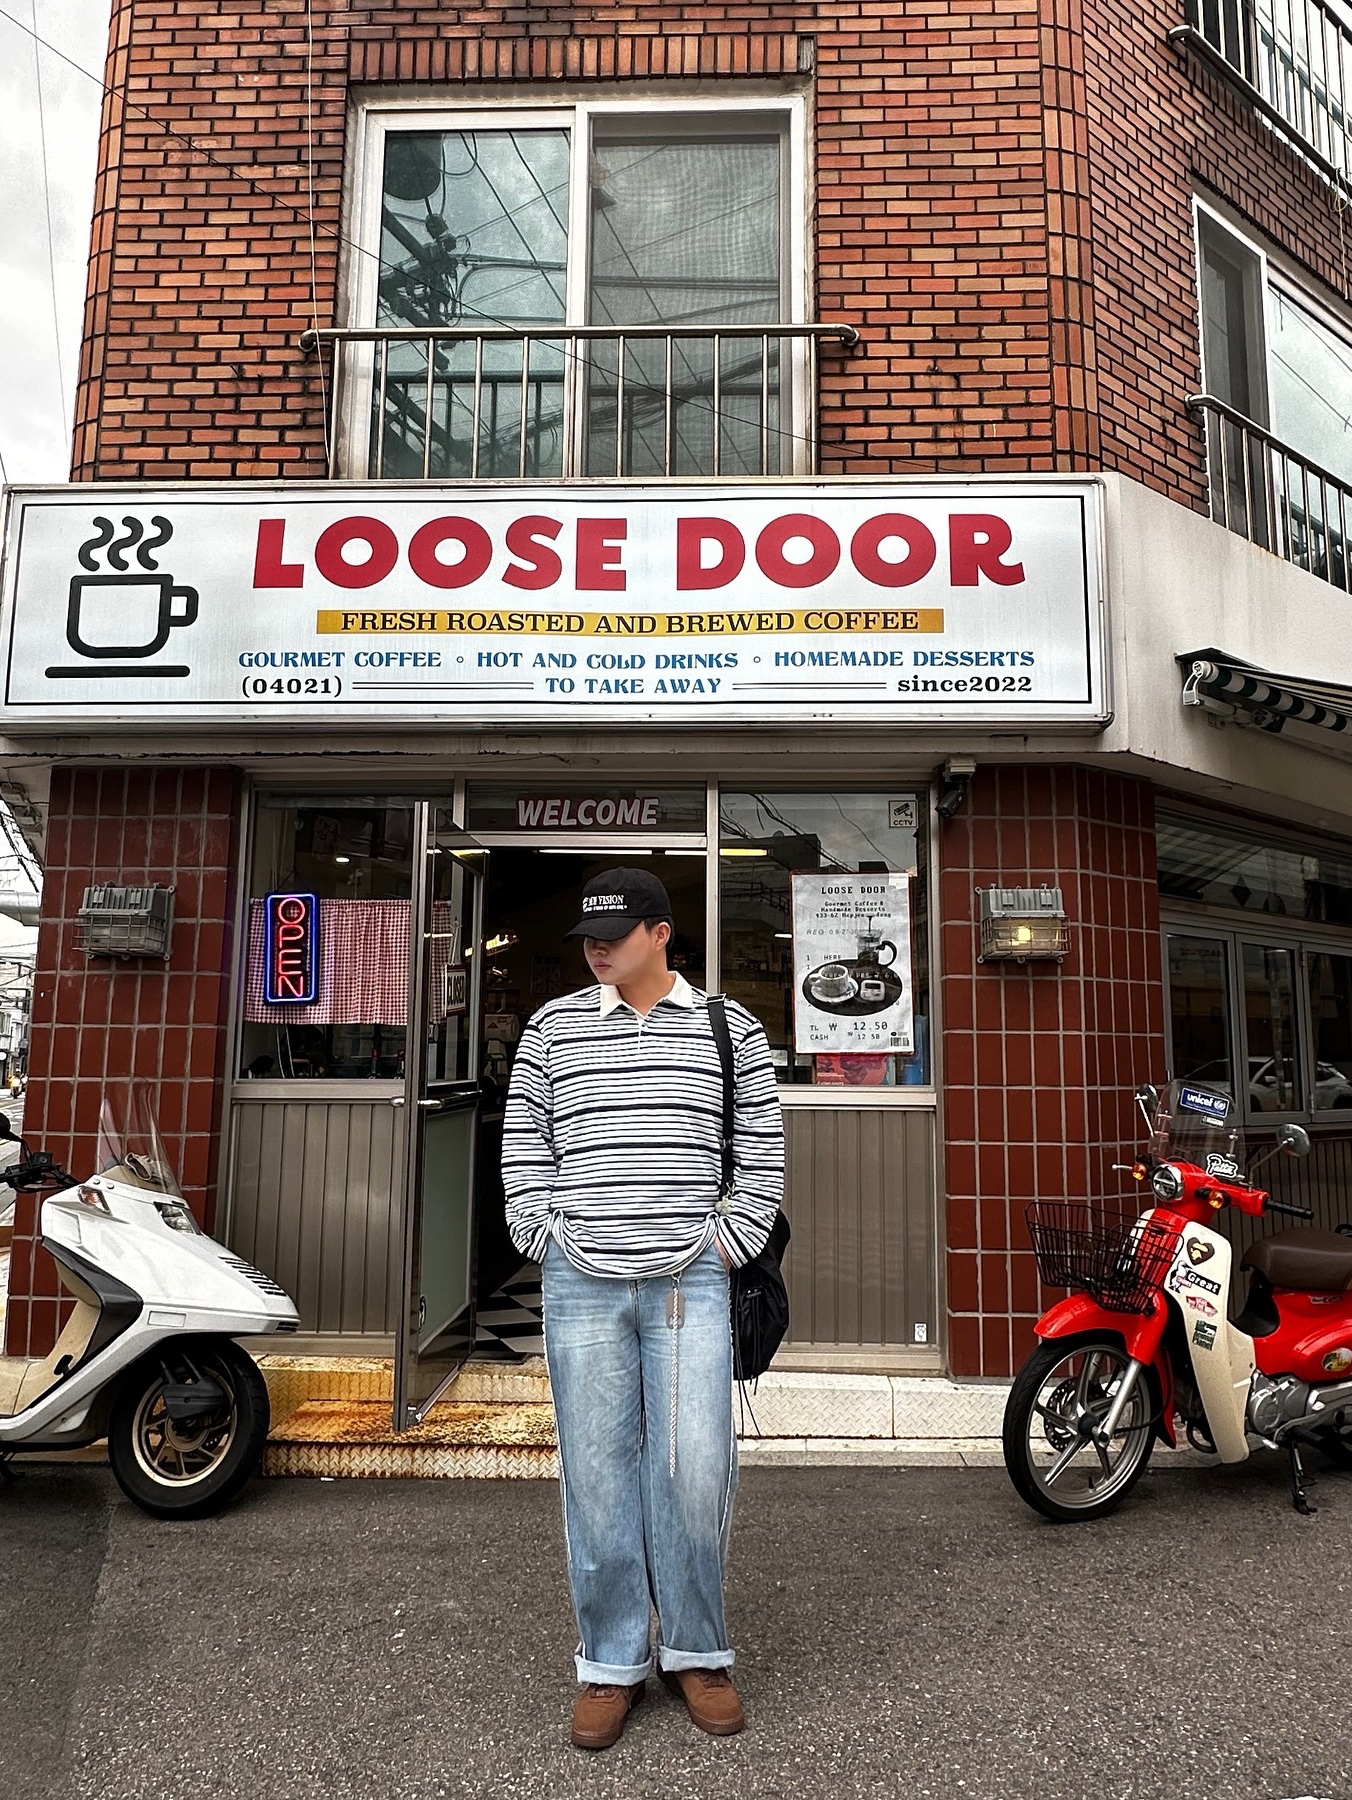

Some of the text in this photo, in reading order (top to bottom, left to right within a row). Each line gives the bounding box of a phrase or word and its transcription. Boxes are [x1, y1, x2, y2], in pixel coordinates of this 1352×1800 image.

[253, 513, 1025, 591] LOOSE DOOR
[341, 611, 919, 634] FRESH ROASTED AND BREWED COFFEE
[239, 650, 1035, 670] GOURMET COFFEE HOT AND COLD DRINKS HOMEMADE DESSERTS
[242, 674, 1033, 698] (04021) TO TAKE AWAY since2022
[518, 798, 660, 827] WELCOME
[821, 886, 886, 895] LOOSE DOOR
[277, 897, 306, 998] OPEN
[853, 1021, 888, 1031] 12.50
[1187, 1094, 1214, 1107] unicef
[1187, 1271, 1219, 1293] Great
